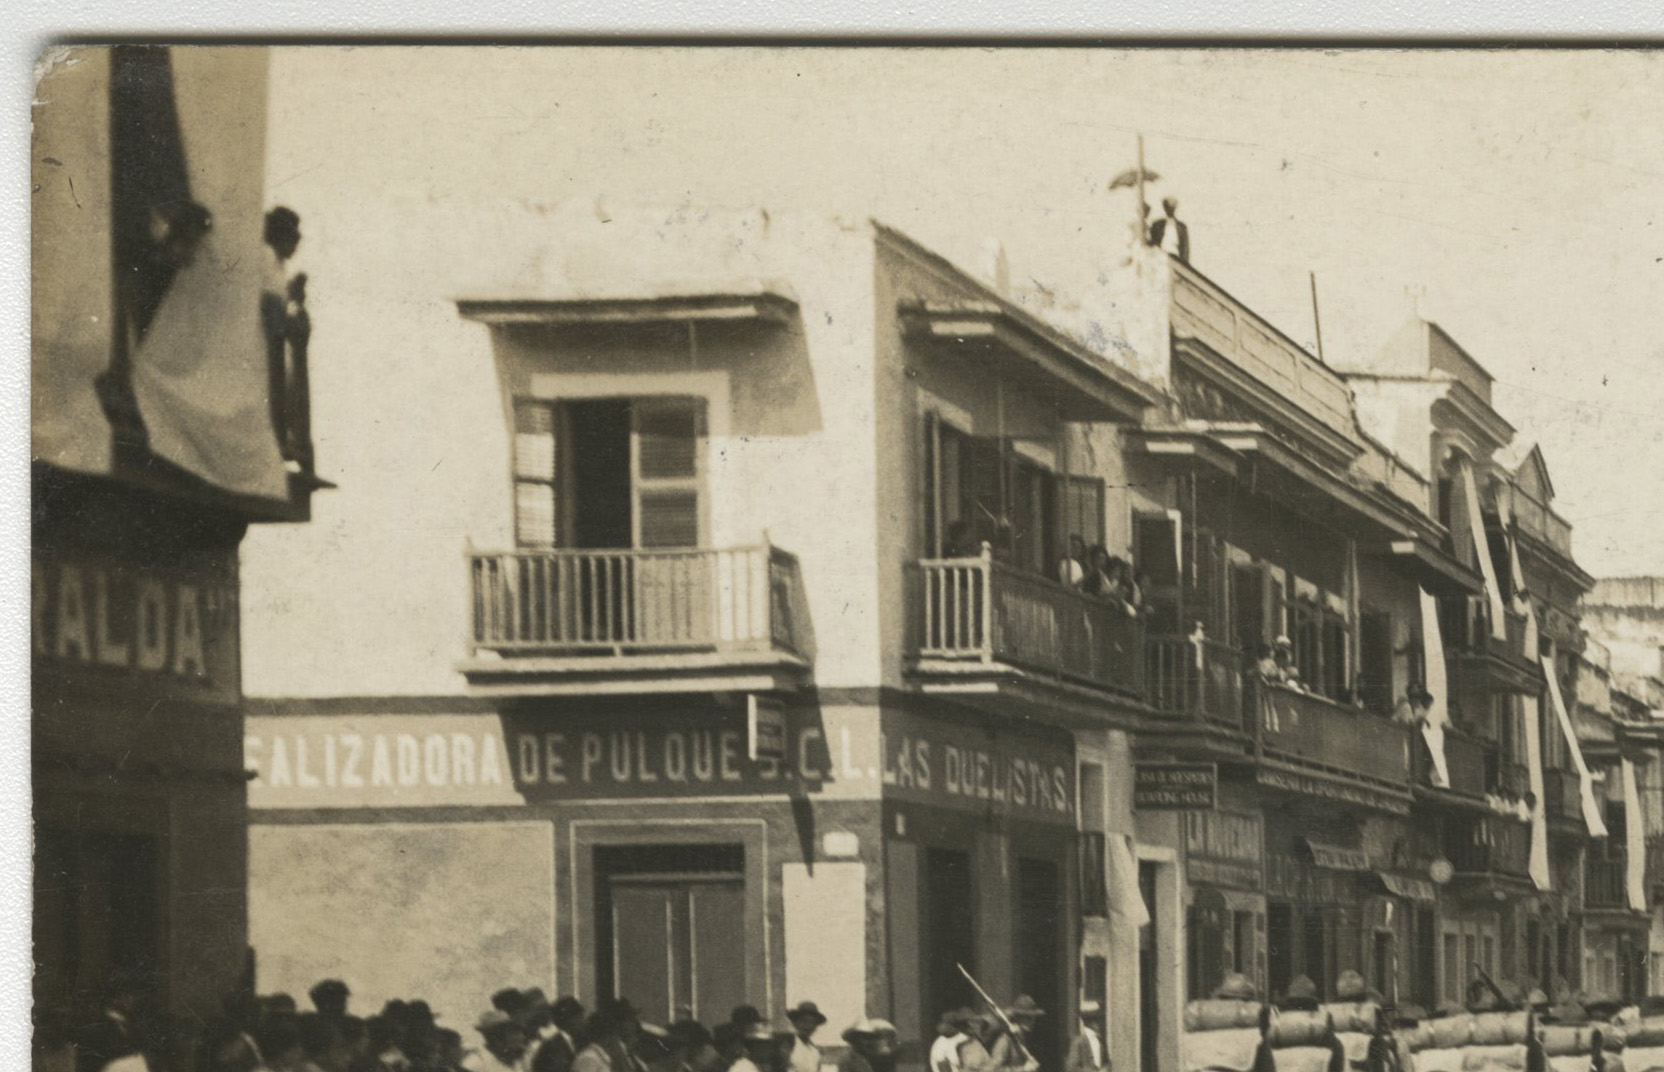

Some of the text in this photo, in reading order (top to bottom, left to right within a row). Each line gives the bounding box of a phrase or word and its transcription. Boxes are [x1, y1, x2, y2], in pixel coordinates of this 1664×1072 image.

[518, 731, 566, 784] DE
[581, 730, 742, 782] PULQUE
[880, 731, 931, 791] LAS
